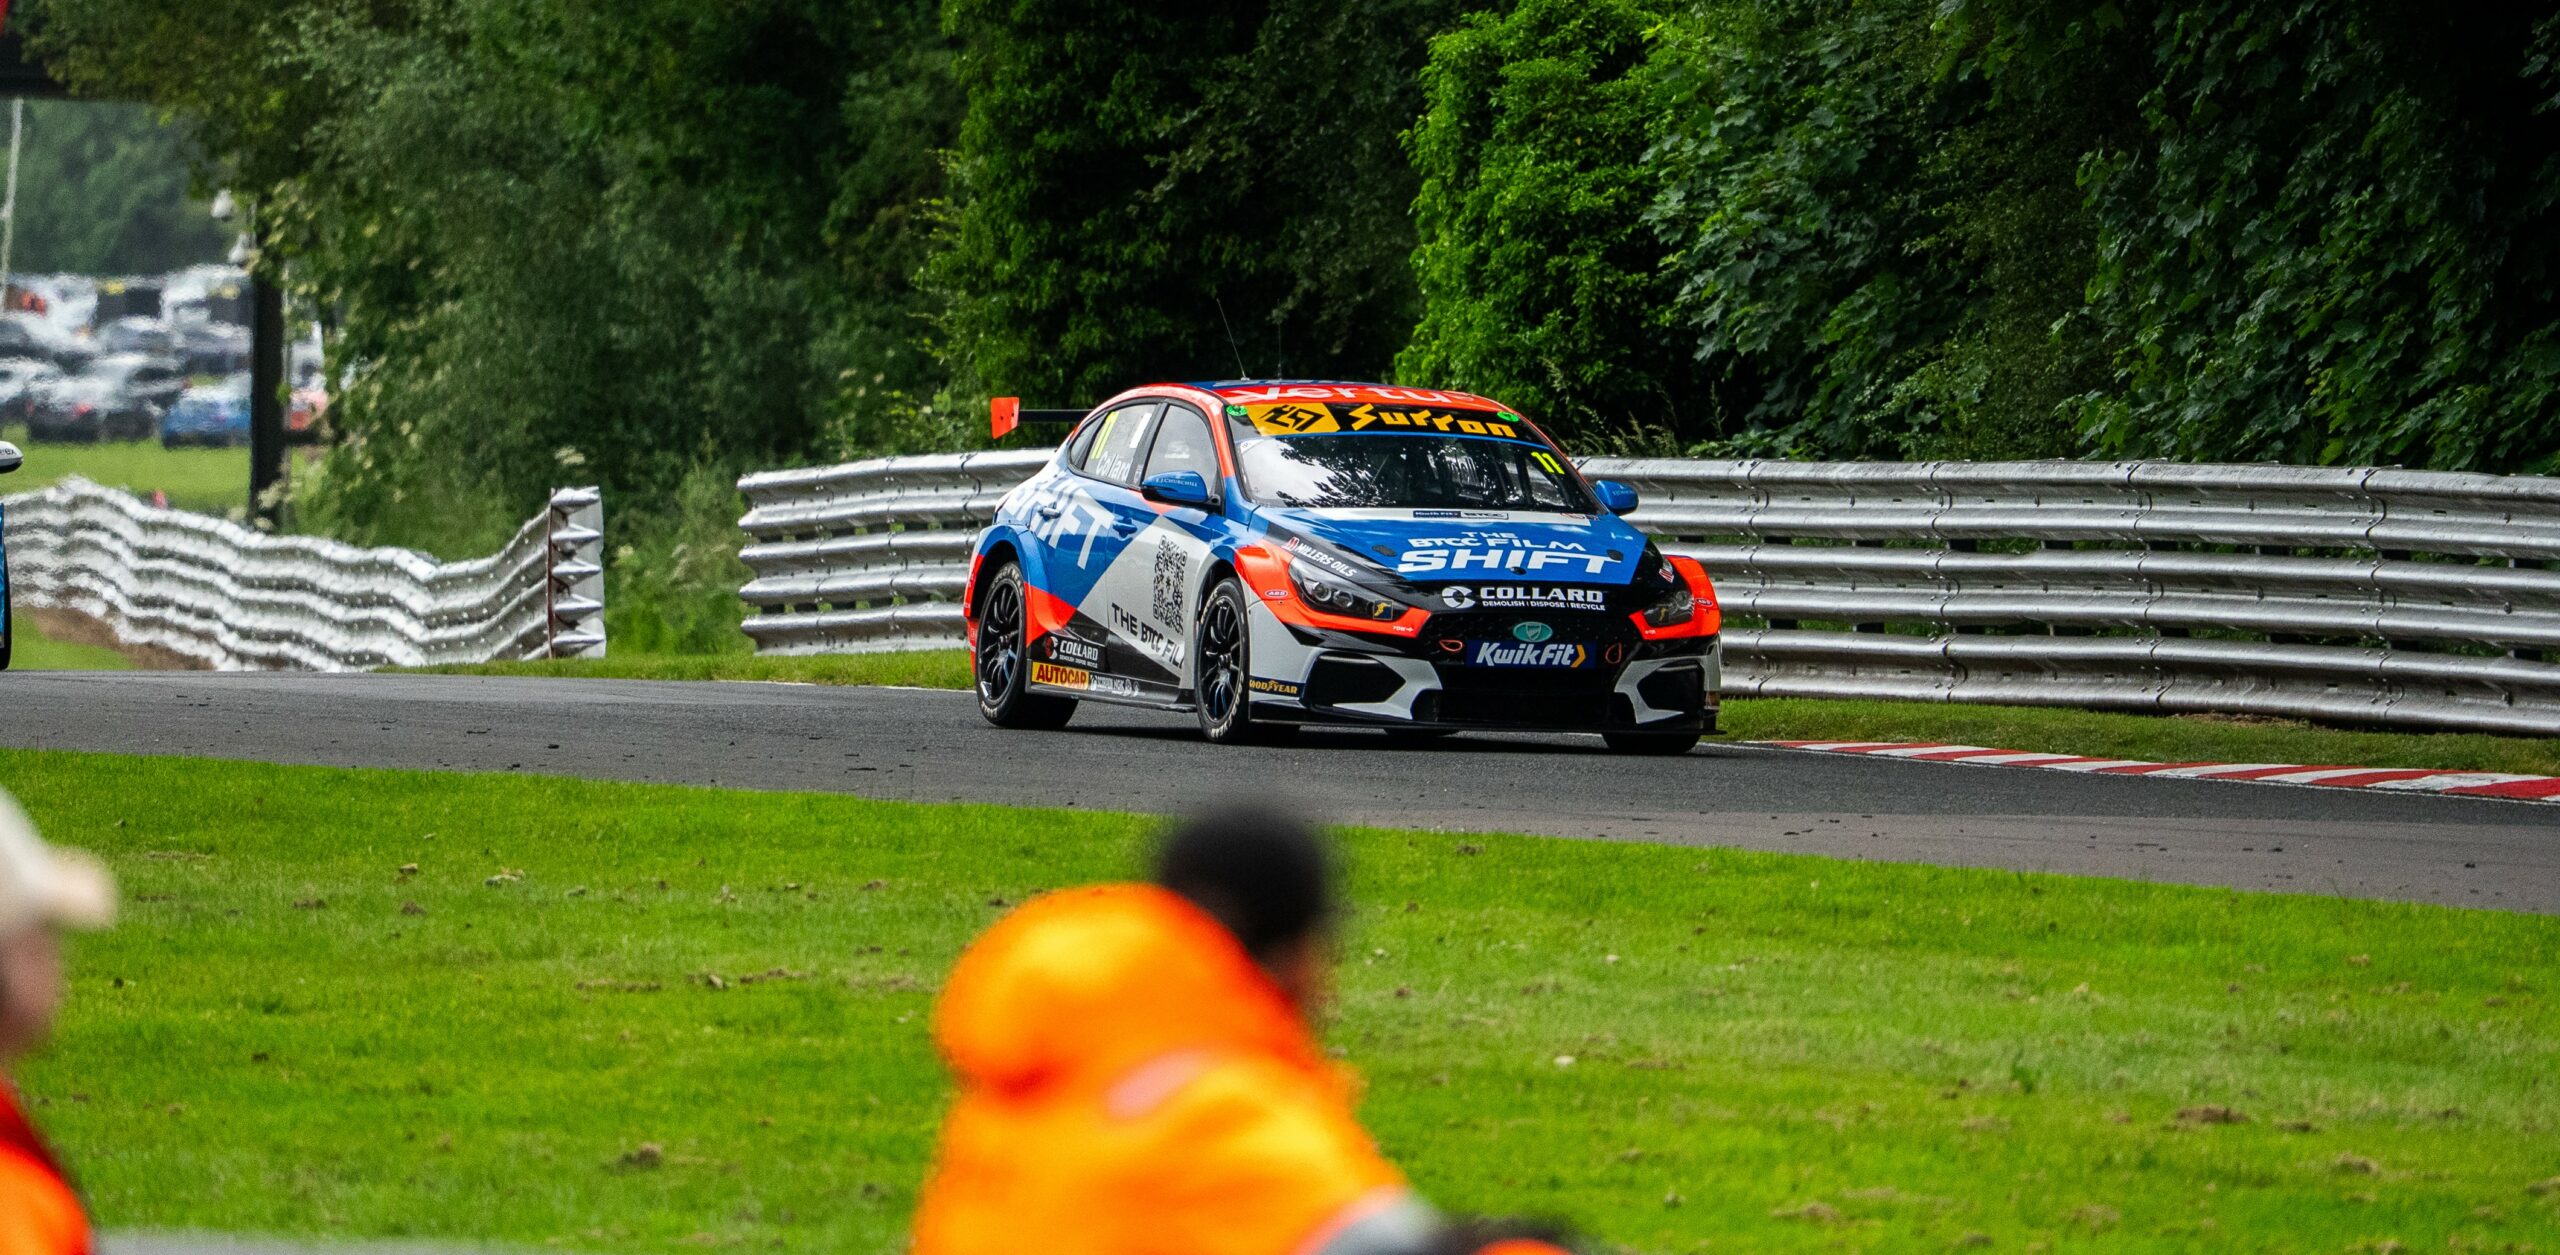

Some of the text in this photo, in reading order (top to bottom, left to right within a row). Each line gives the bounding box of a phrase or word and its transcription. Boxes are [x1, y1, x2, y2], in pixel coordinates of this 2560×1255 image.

[1349, 403, 1517, 438] Surron
[1530, 451, 1565, 475] 11
[1408, 538, 1586, 551] BTCC FILM
[1294, 543, 1358, 577] MILLERS OILS
[1397, 549, 1621, 574] SHIFT
[1480, 587, 1603, 603] COLLARD
[1530, 601, 1566, 609] DISPOSE
[1570, 602, 1607, 611] RECYCLE
[1111, 602, 1138, 637] THE
[1140, 621, 1164, 653] BTCC
[1060, 640, 1099, 661] COLLARD
[1036, 664, 1087, 688] AUTOCAR
